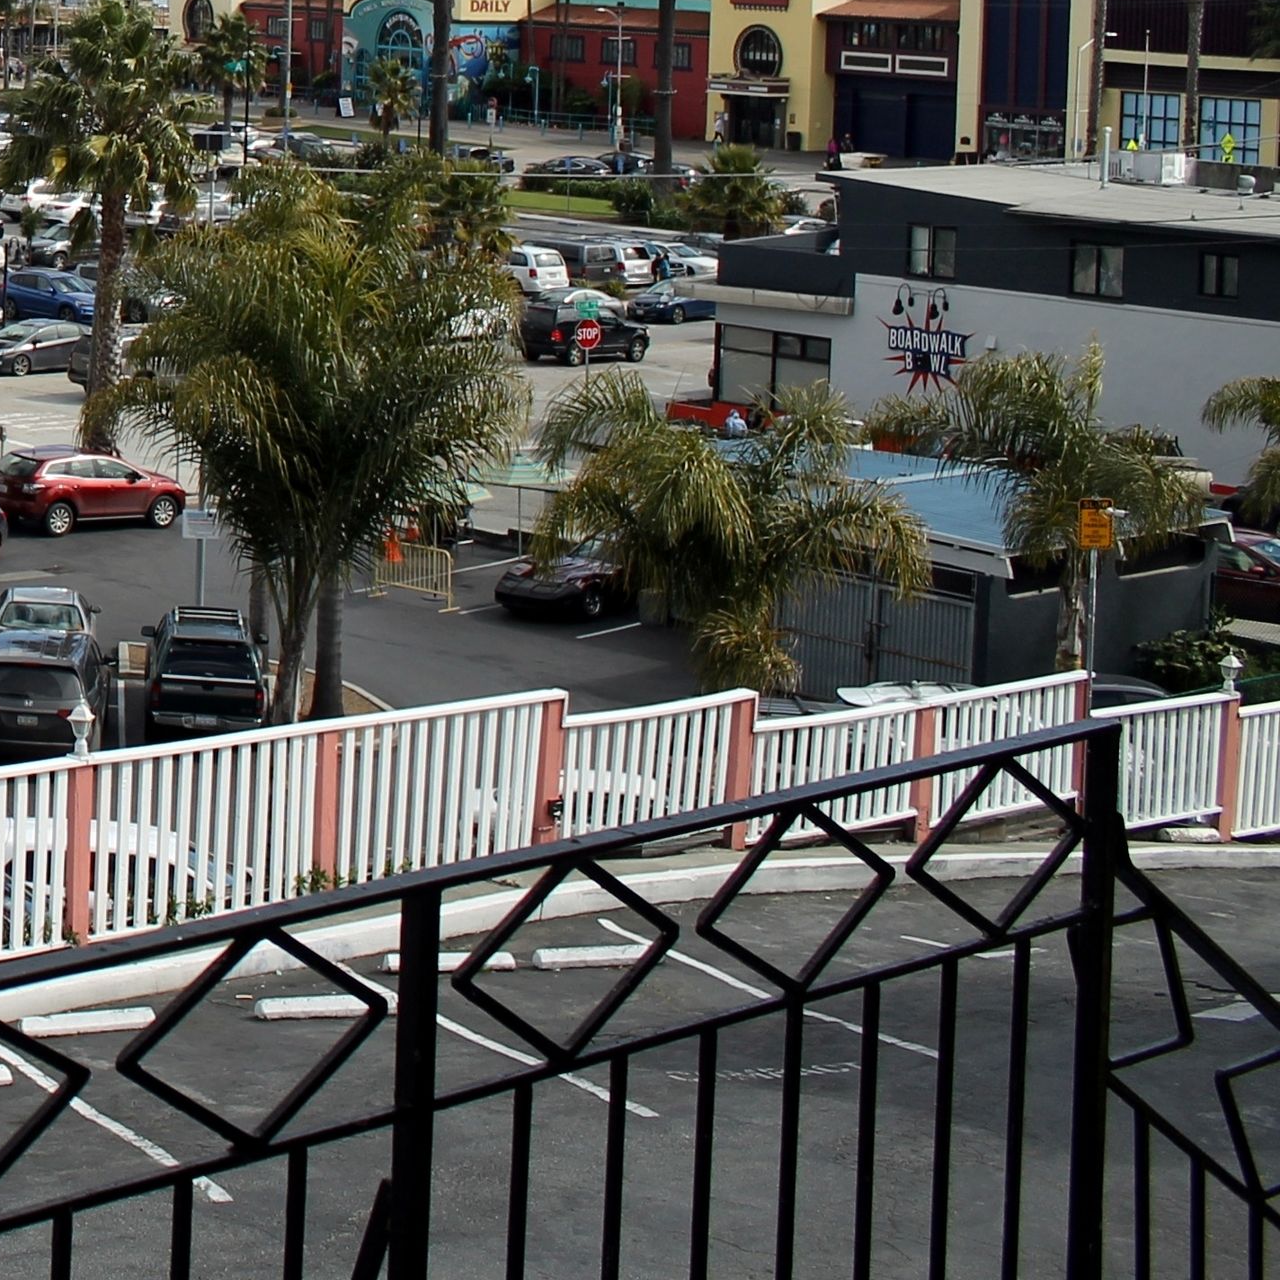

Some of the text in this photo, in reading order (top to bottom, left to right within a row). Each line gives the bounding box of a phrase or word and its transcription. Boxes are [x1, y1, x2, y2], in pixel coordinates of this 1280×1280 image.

[470, 0, 511, 13] DAILY
[577, 327, 598, 340] STOP
[889, 328, 962, 356] BOARDWALK
